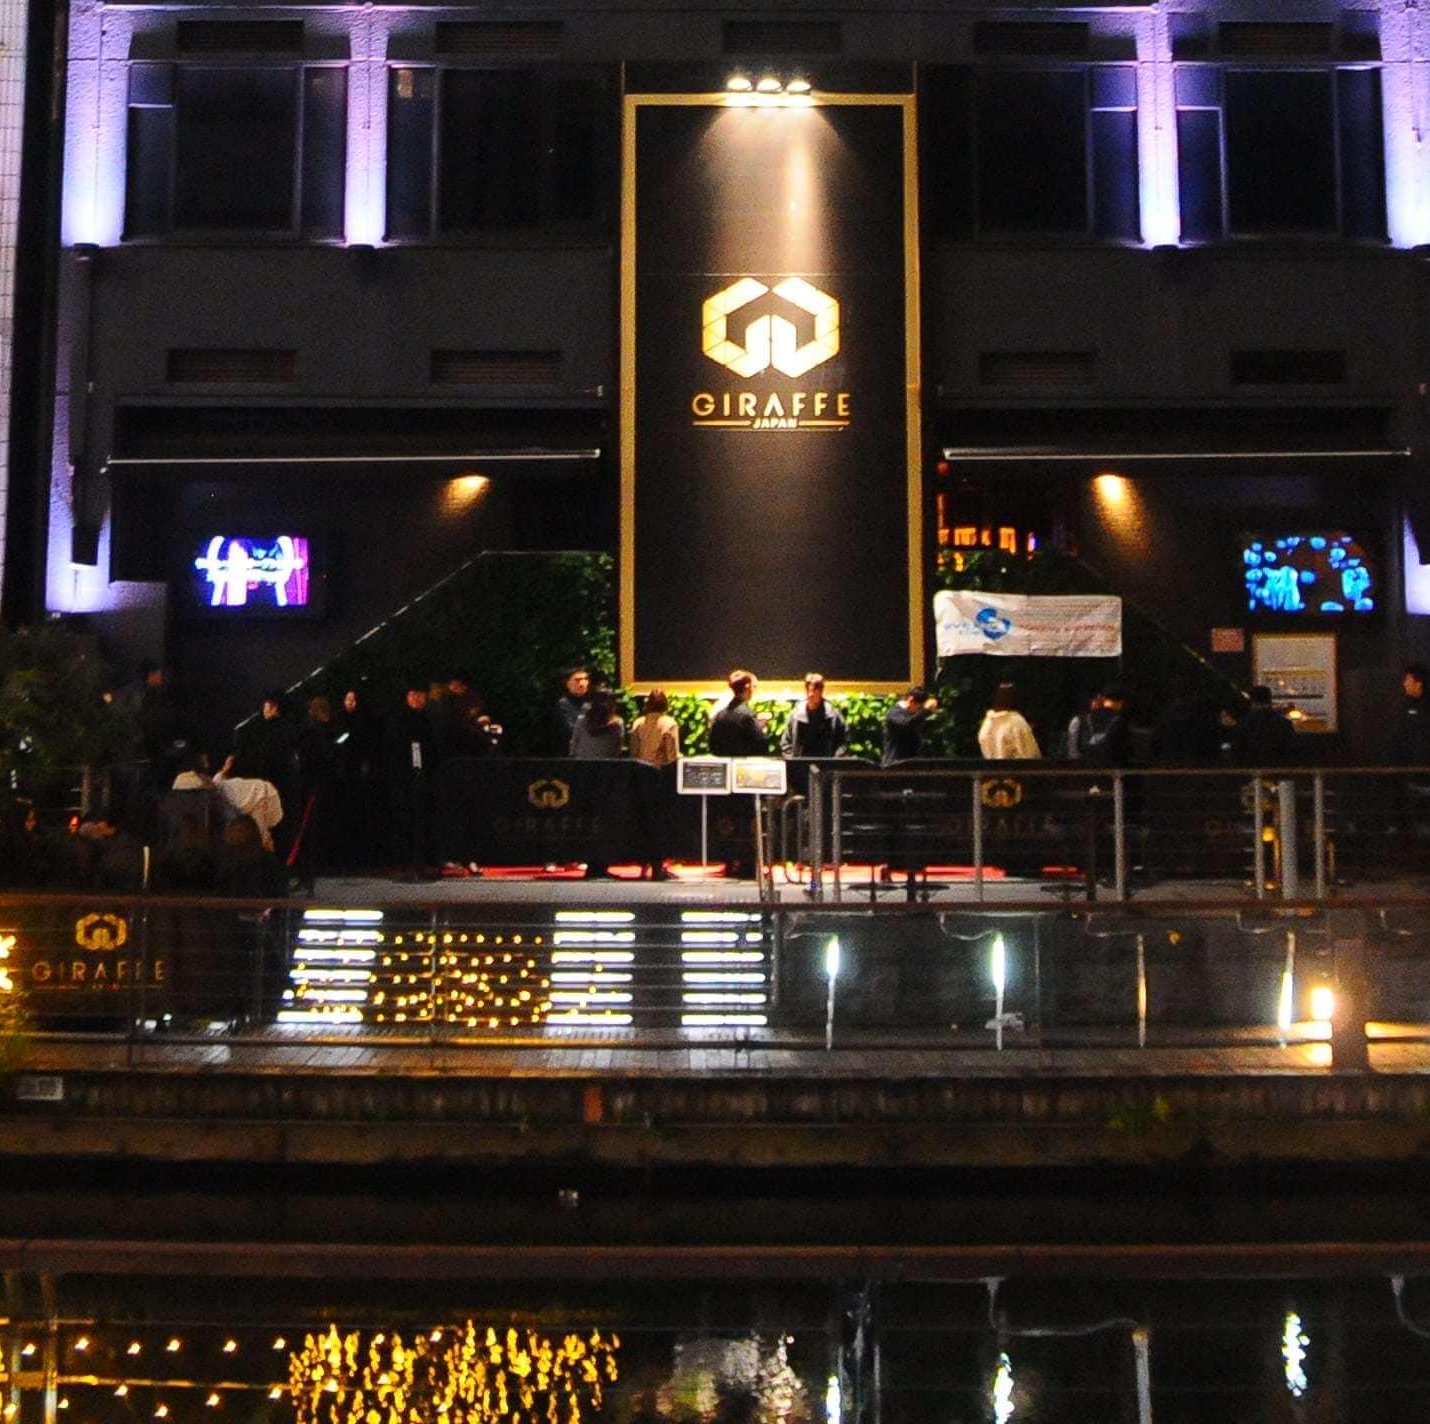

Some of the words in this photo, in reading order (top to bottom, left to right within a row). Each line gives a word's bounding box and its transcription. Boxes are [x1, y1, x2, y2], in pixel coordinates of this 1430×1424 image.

[692, 392, 851, 417] GIRAFFE
[753, 418, 798, 429] JAPAN
[32, 959, 166, 983] GIRAFFE
